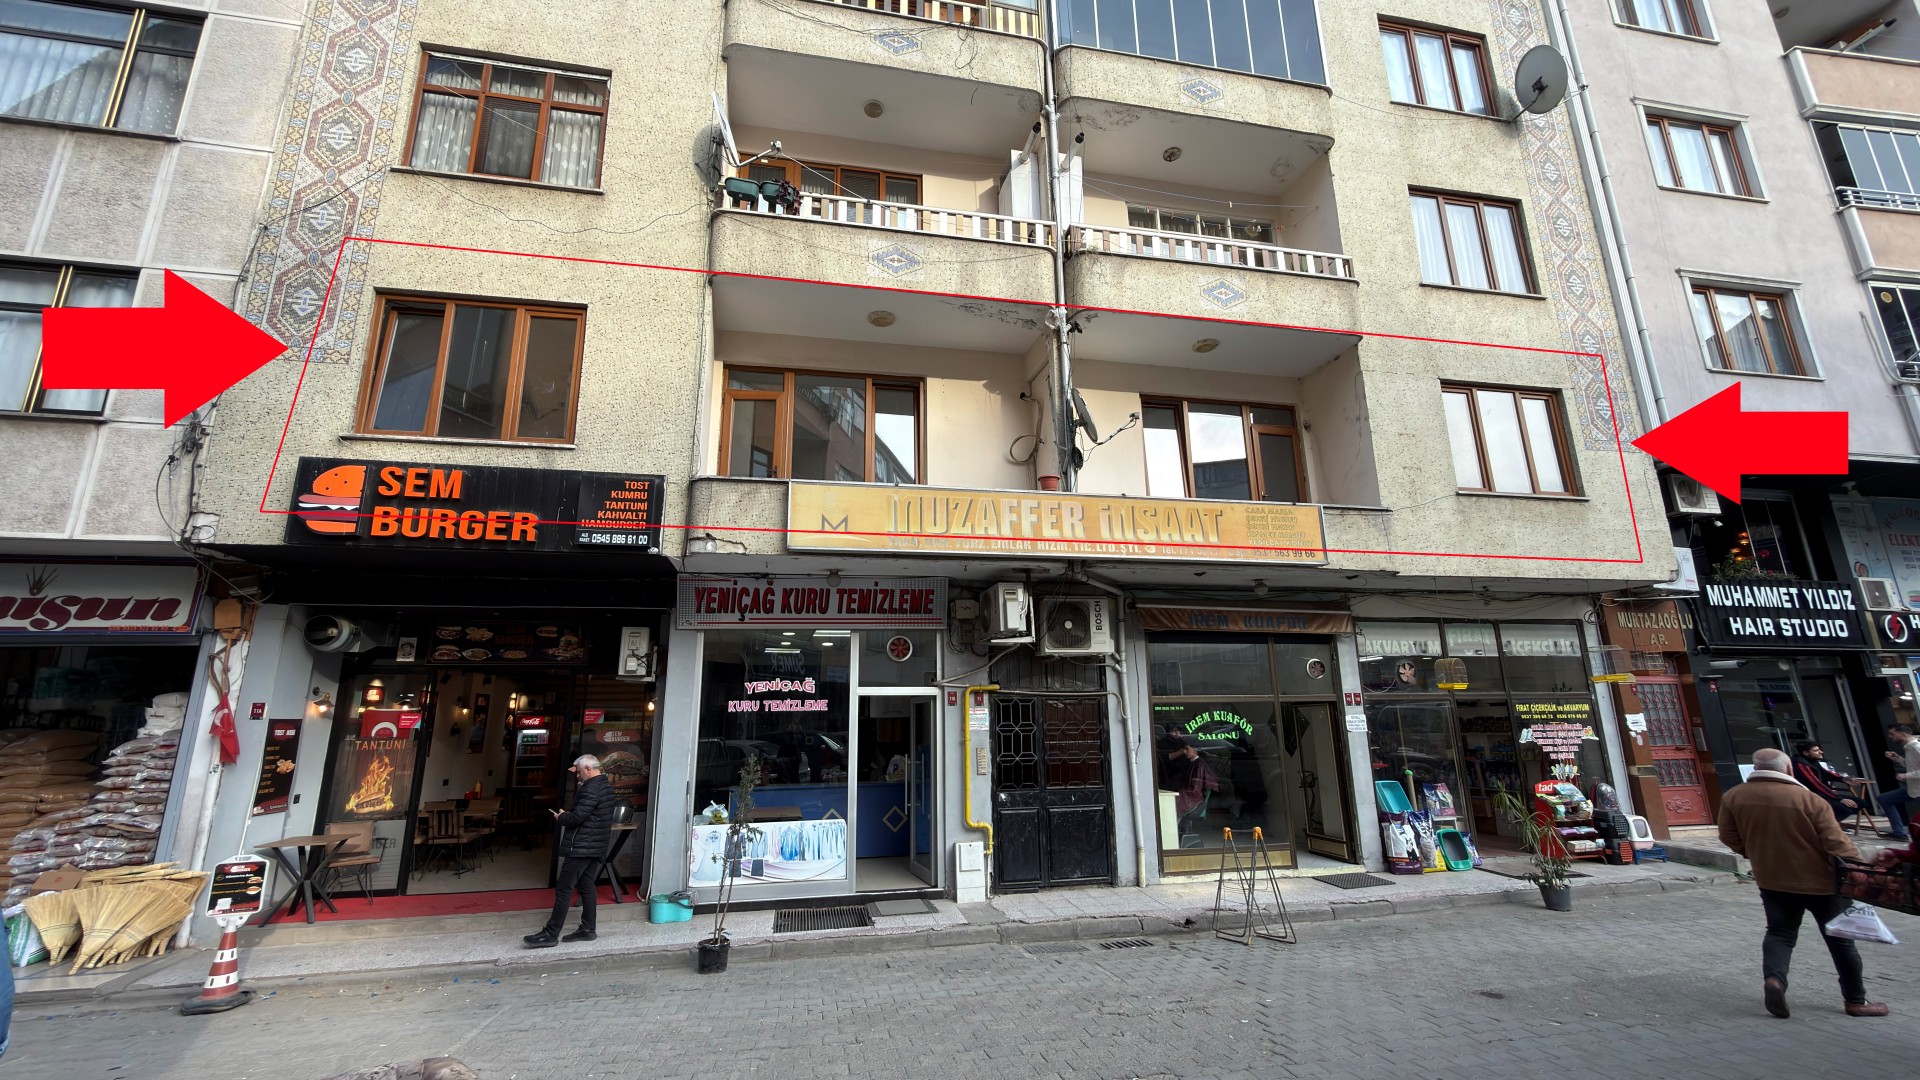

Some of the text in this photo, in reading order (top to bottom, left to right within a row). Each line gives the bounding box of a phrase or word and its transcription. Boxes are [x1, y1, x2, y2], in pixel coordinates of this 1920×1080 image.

[378, 466, 463, 499] SEM
[624, 481, 650, 490] TOST
[611, 490, 648, 499] KUMRU
[605, 501, 648, 510] TANTUNİ
[370, 505, 538, 542] BURGER
[597, 510, 647, 520] KAHVALTI
[886, 493, 1085, 539] MUZAFFER
[592, 533, 610, 543] 0545
[627, 535, 636, 544] 61
[638, 535, 648, 545] 00
[694, 579, 935, 621] YENİÇAĞ KURU TEMİZLEME
[1705, 584, 1856, 611] MUHAMMET YILDIZ
[1094, 600, 1103, 631] BOSCH
[1617, 609, 1694, 630] MURTAZAOĞLU
[1729, 616, 1849, 638] HAIR STUDIO
[1365, 639, 1441, 654] AKVARYUM
[745, 677, 815, 694] YENİÇAĞ
[728, 698, 829, 712] KURU TEMİZLEME
[1184, 711, 1211, 734] İREM
[355, 738, 407, 751] TANTUNİ
[1198, 731, 1240, 741] SALONU
